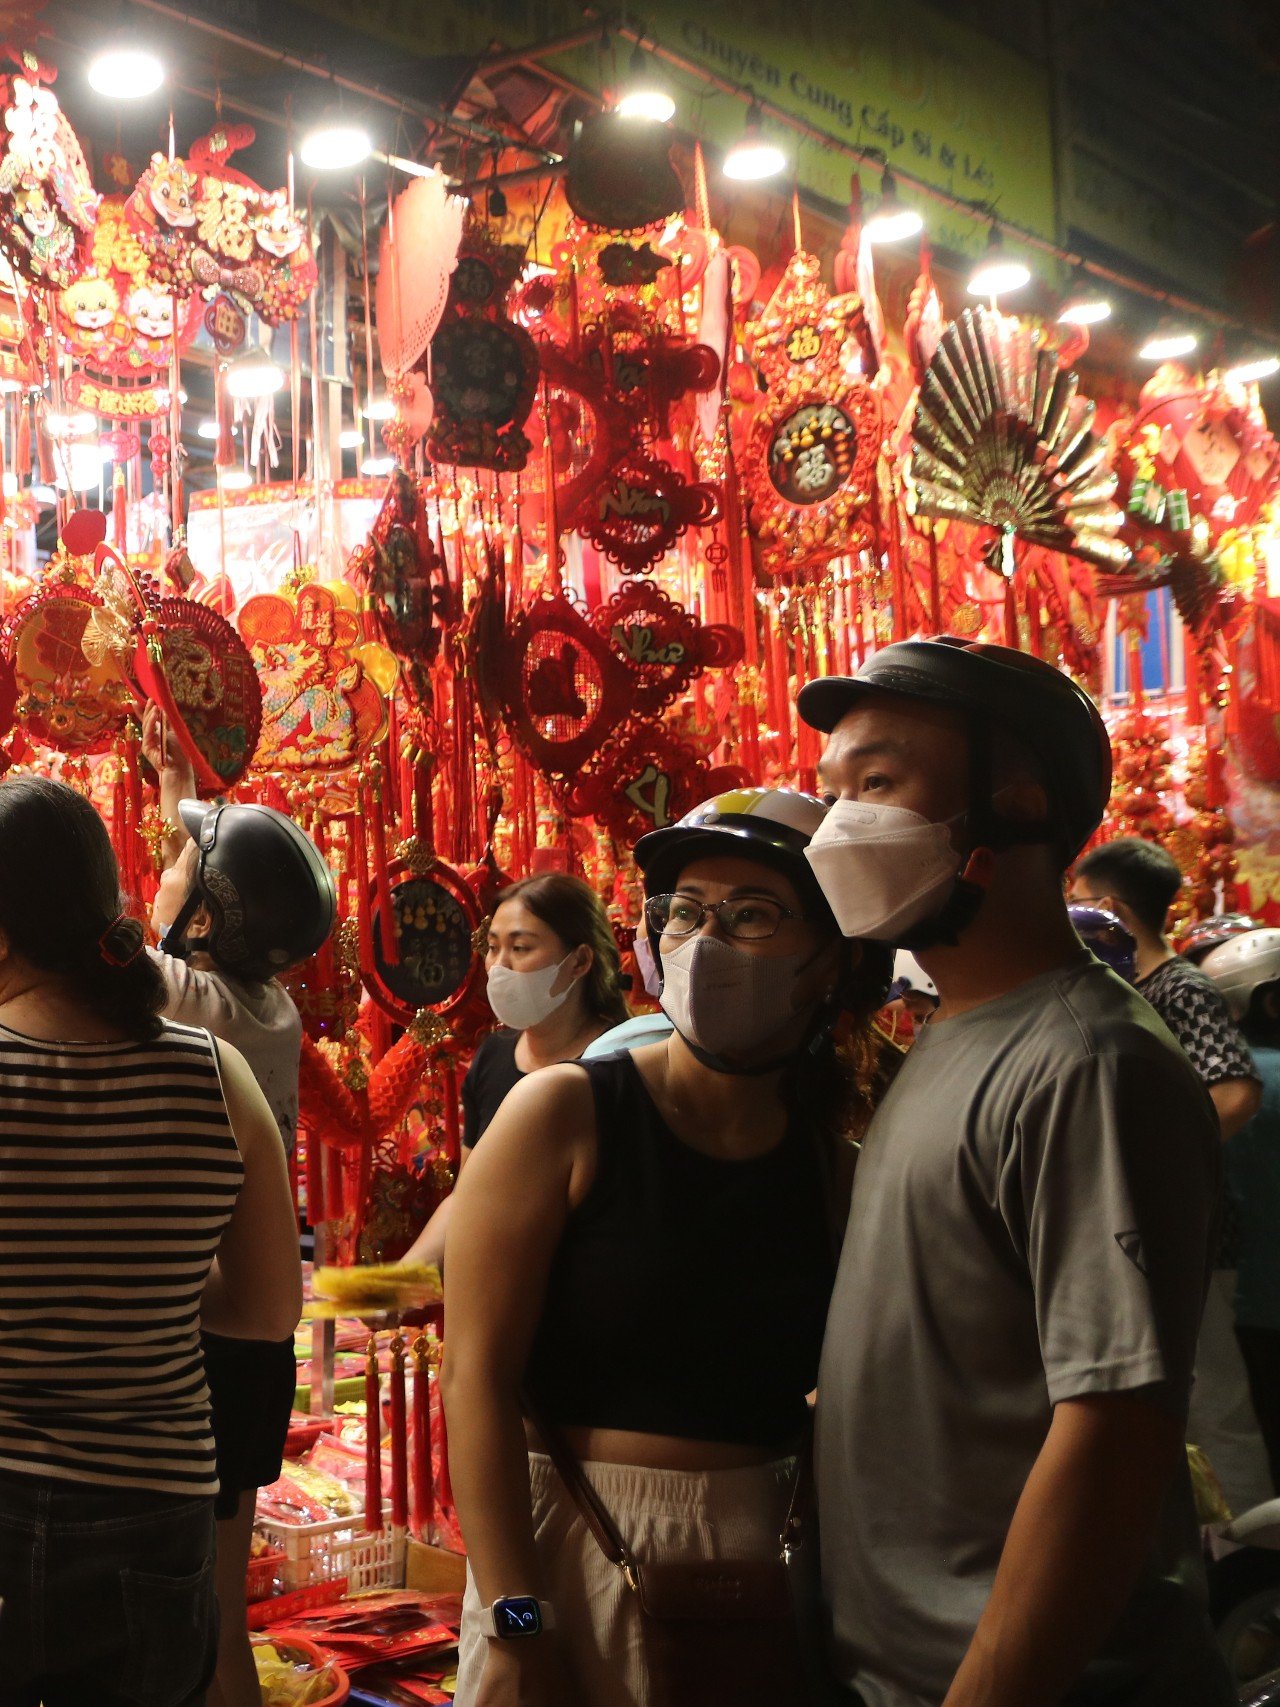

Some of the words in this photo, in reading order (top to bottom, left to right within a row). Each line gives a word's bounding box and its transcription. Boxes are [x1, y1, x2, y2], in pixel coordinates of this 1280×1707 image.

[681, 20, 781, 89] Chuyên
[789, 70, 853, 129] Cung
[860, 104, 905, 150] Cấp
[939, 142, 957, 170] &
[787, 325, 821, 361] 福
[794, 443, 835, 492] 福
